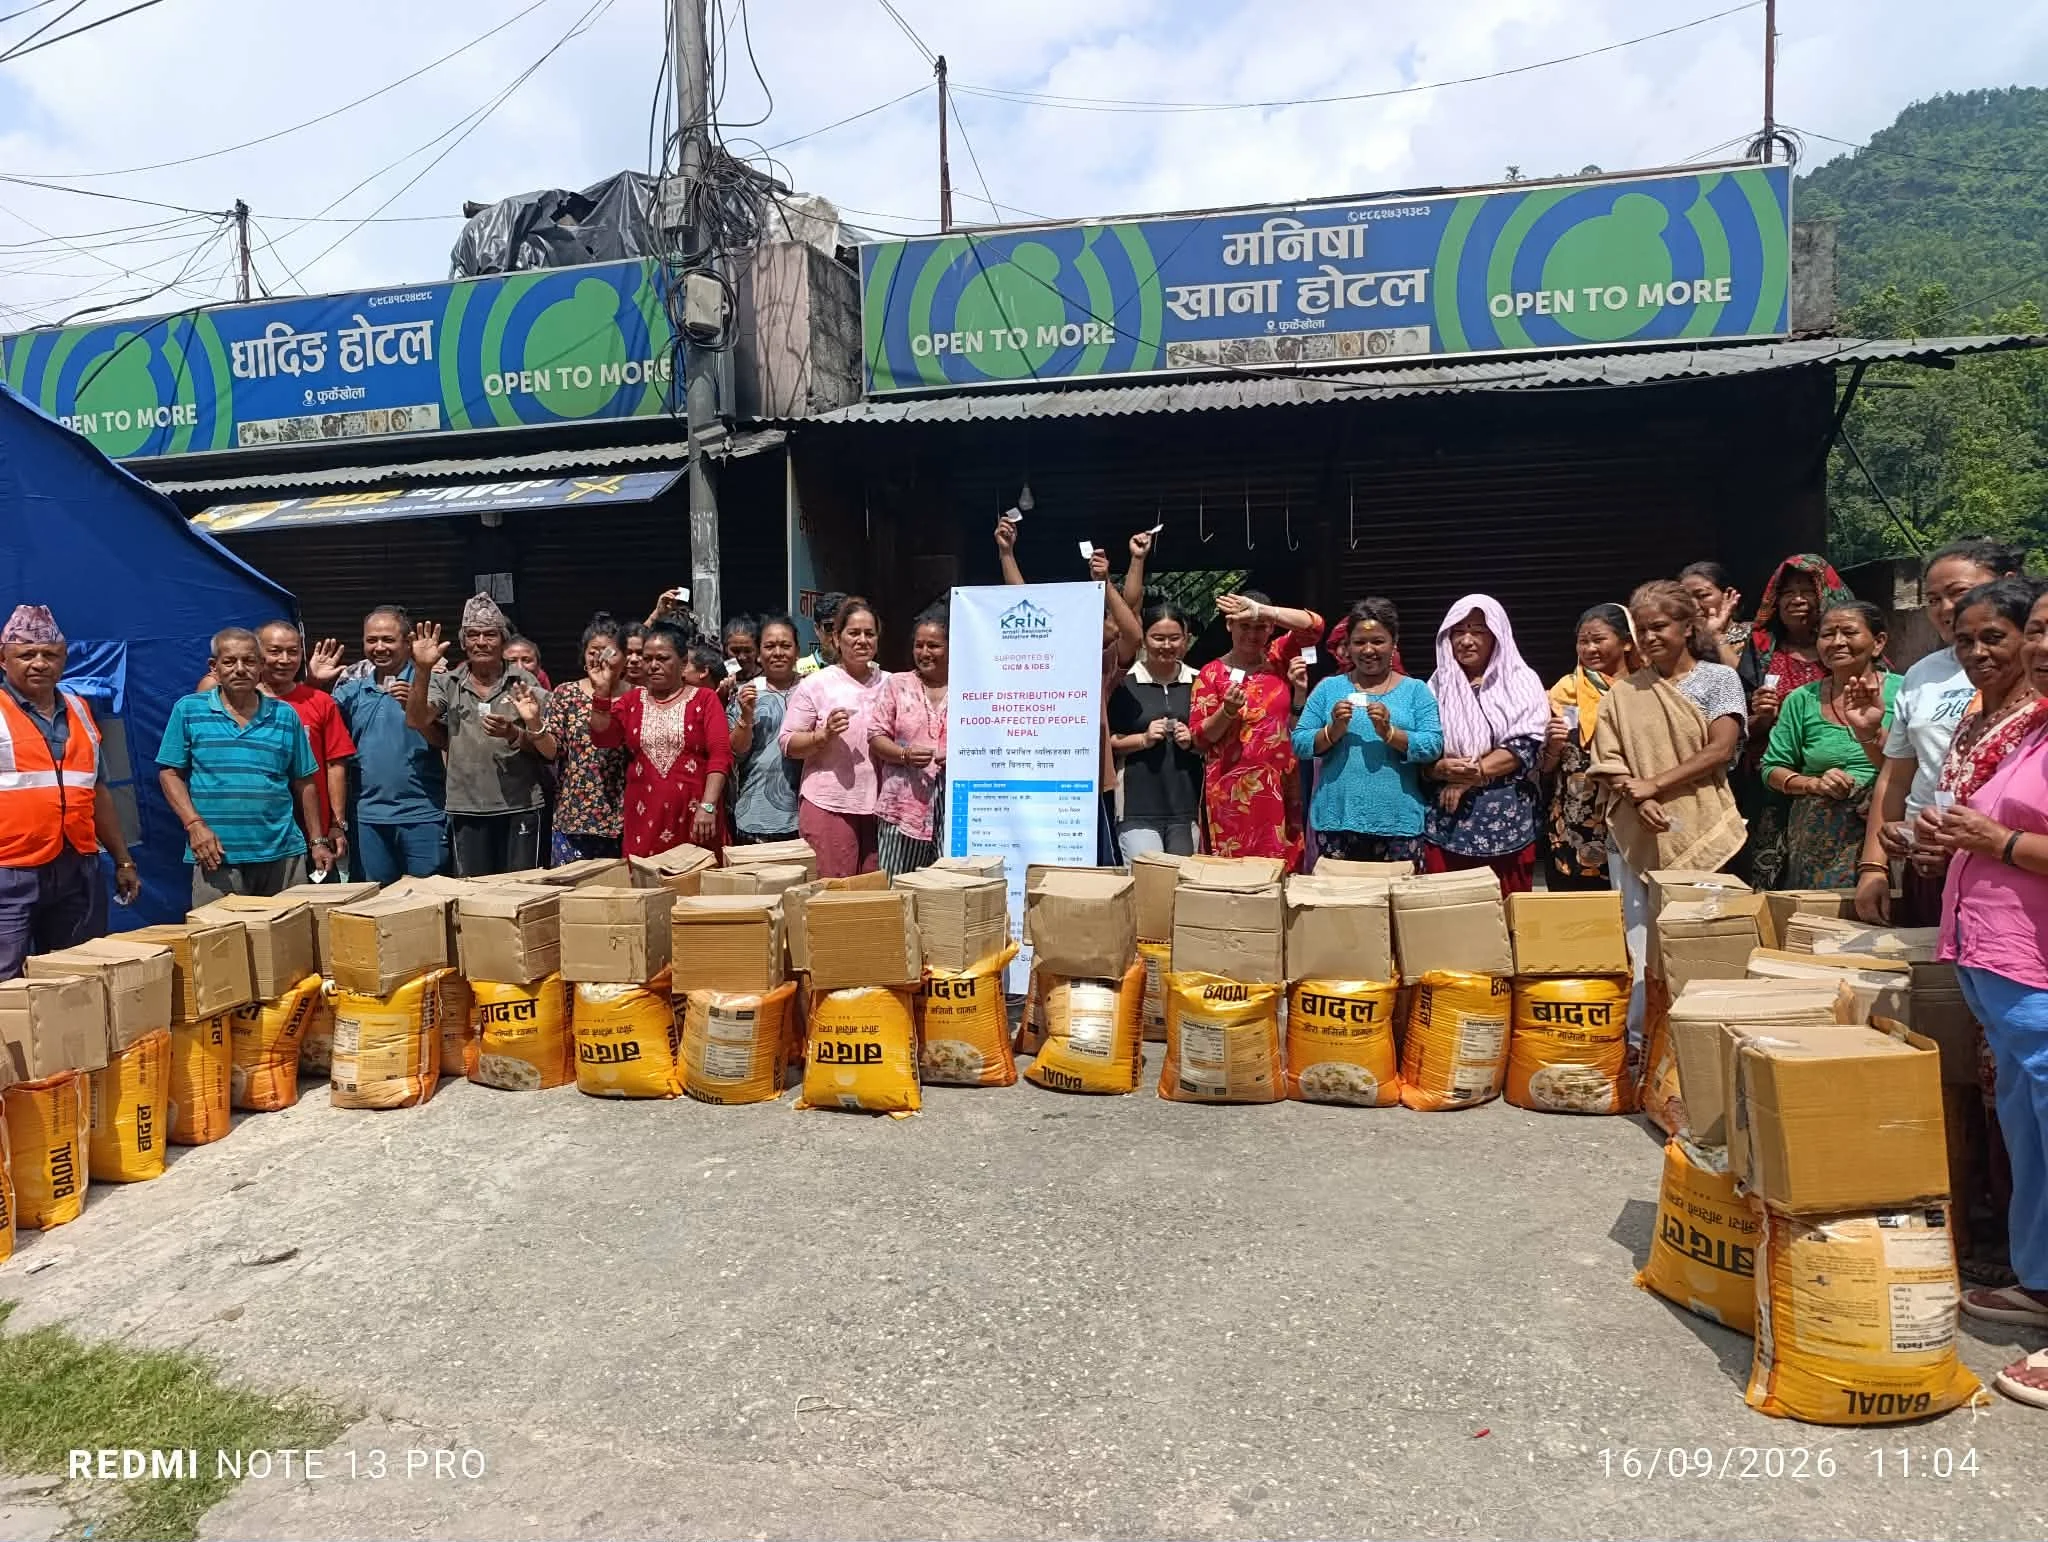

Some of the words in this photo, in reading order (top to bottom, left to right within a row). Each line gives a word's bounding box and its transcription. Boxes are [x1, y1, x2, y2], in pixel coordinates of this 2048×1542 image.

[1222, 217, 1369, 266] मनिषा
[1165, 279, 1282, 321] खाना
[1297, 264, 1430, 315] होटल
[1489, 288, 1575, 318] OPEN
[1583, 286, 1629, 312] TO
[1637, 277, 1732, 308] MORE
[231, 321, 328, 379] धादिङ
[338, 314, 434, 373] होटल
[911, 330, 983, 357] OPEN
[990, 327, 1028, 351] TO
[1036, 322, 1116, 348] MORE
[484, 368, 551, 396] OPEN
[556, 365, 593, 390] TO
[600, 358, 674, 387] MORE
[58, 412, 98, 435] PEN
[101, 409, 132, 433] TO
[137, 403, 198, 429] MORE
[1001, 612, 1046, 628] KRIN
[994, 654, 1042, 662] SUPPORTED
[1044, 653, 1055, 661] BY
[962, 692, 994, 701] RELIEF
[996, 691, 1065, 700] DISTRIBUTION
[1068, 690, 1088, 699] FOR
[992, 704, 1056, 712] BHOTEKOSHI
[960, 717, 1045, 725] FLOOD-AFFECTED
[1007, 729, 1039, 737] NEPAL
[480, 998, 539, 1025] बादल
[1301, 991, 1378, 1023] बादल
[1530, 1001, 1614, 1026] बादल
[579, 1041, 642, 1065] बादल
[815, 1041, 884, 1065] बादल
[137, 1104, 152, 1153] बादल
[50, 1142, 75, 1200] BADAL
[1659, 1213, 1755, 1278] बादल
[1841, 1389, 1931, 1416] BADAL
